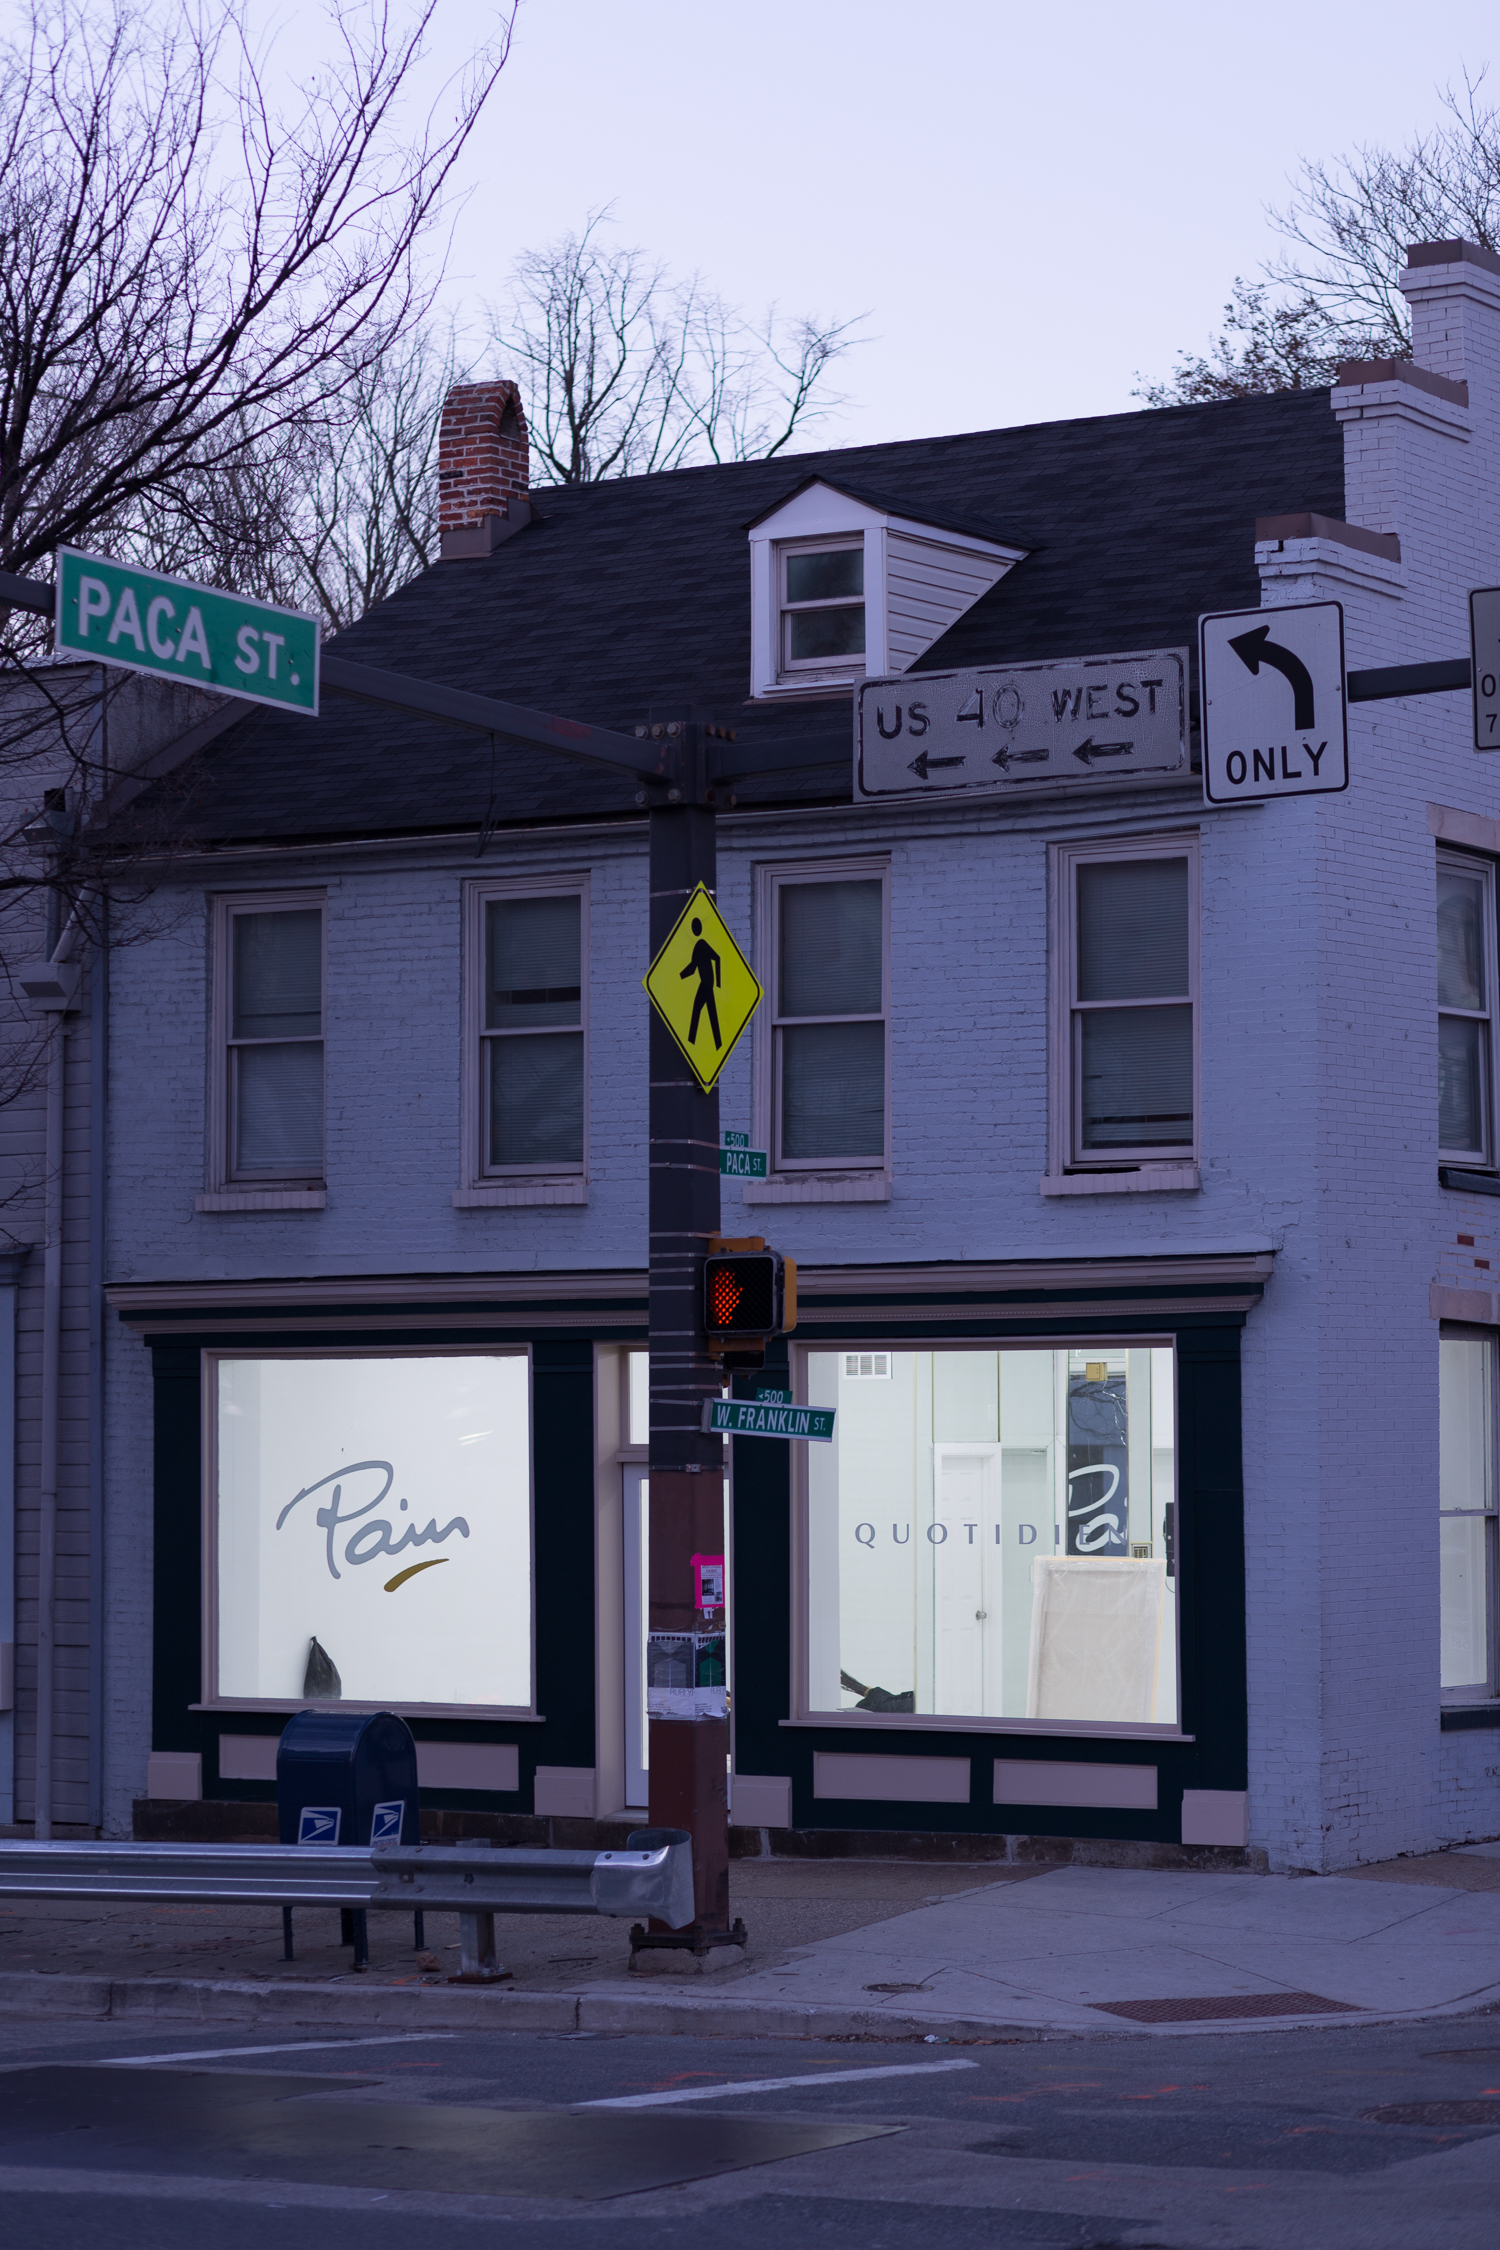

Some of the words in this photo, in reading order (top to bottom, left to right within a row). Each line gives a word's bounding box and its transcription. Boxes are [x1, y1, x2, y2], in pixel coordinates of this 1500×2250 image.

[78, 574, 213, 670] PACA
[234, 625, 300, 687] ST.
[1481, 673, 1500, 698] O
[876, 701, 931, 740] US
[956, 683, 1025, 730] 40
[1051, 679, 1164, 723] WEST
[1226, 741, 1329, 785] ONLY
[730, 1133, 745, 1148] 500
[726, 1152, 751, 1175] PACA
[752, 1157, 763, 1171] ST.
[763, 1389, 784, 1404] 500
[716, 1404, 732, 1428] W.
[737, 1406, 811, 1434] FRANKLIN
[813, 1417, 826, 1431] ST.
[276, 1460, 470, 1580] Pain
[854, 1522, 1128, 1549] QUOTIDIEN
